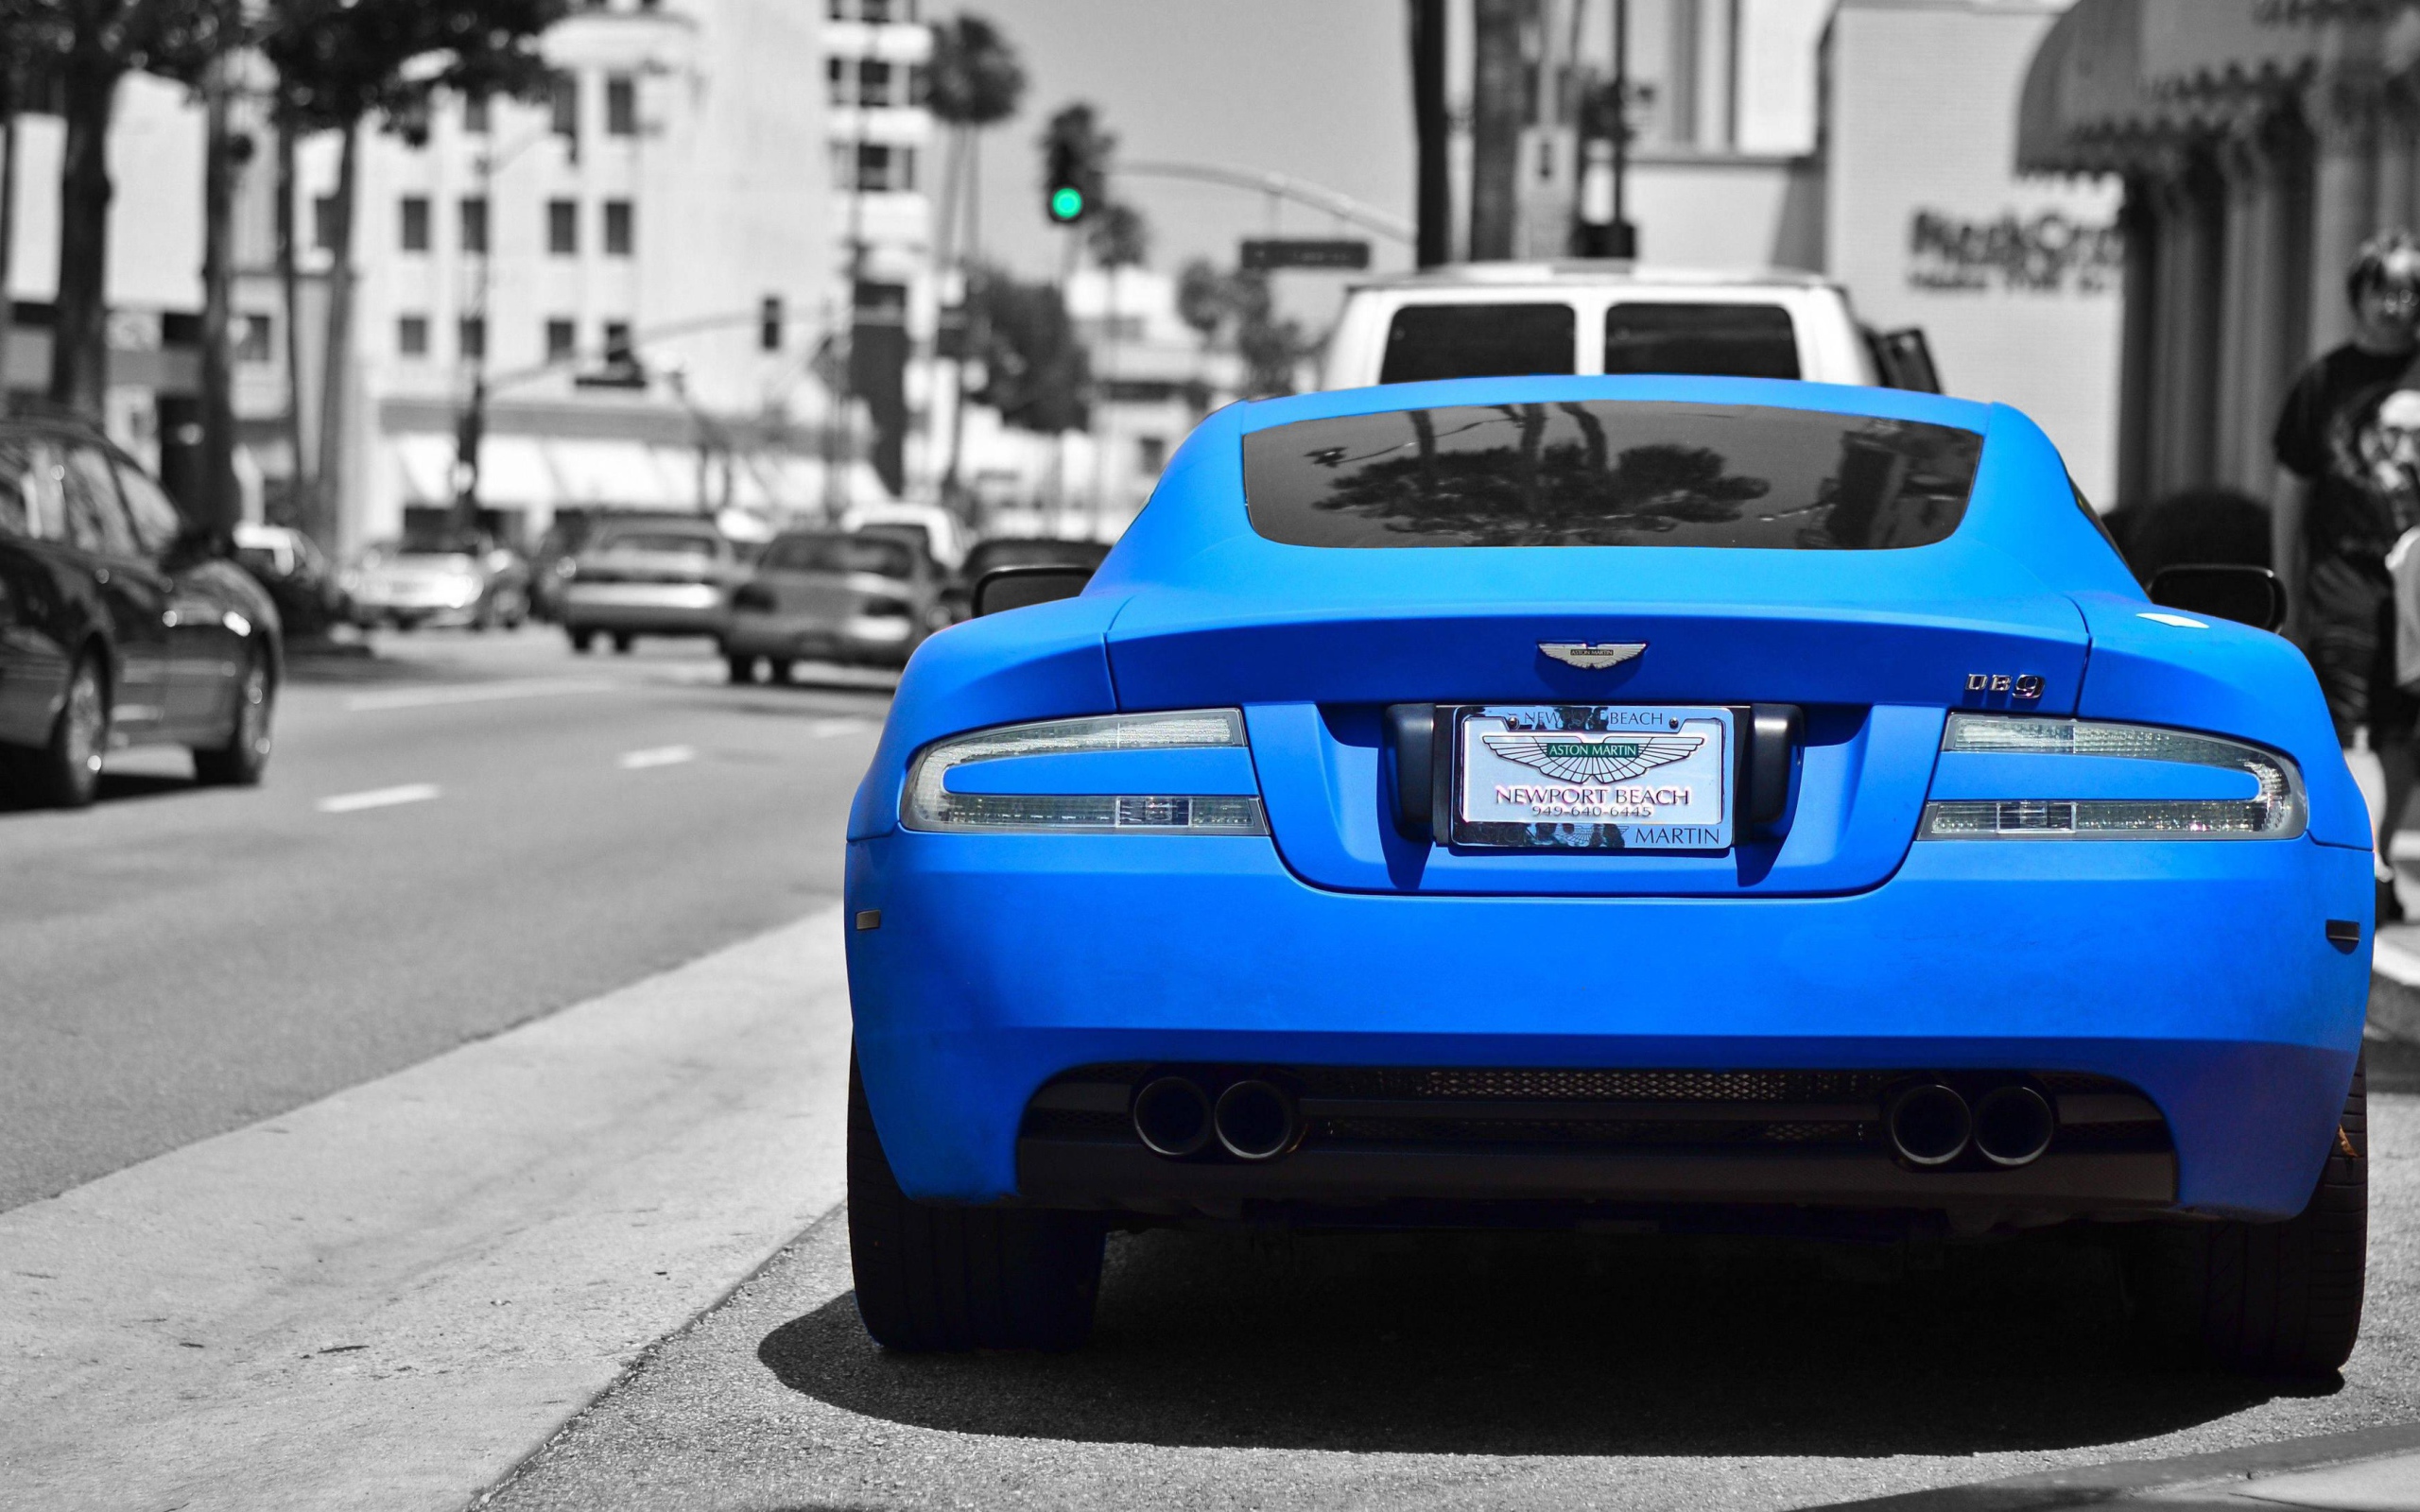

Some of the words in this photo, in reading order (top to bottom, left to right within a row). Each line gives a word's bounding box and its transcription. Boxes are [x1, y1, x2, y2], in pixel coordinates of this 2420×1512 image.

[1965, 674, 2045, 698] DB9
[1610, 713, 1663, 726] BEACH
[1549, 745, 1589, 755] ASTON
[1591, 745, 1636, 756] MARTIN
[1495, 787, 1609, 804] NEWPORT
[1615, 788, 1689, 805] BEACH
[1531, 805, 1652, 817] 949-640-6445
[1634, 827, 1720, 845] MARTIN
